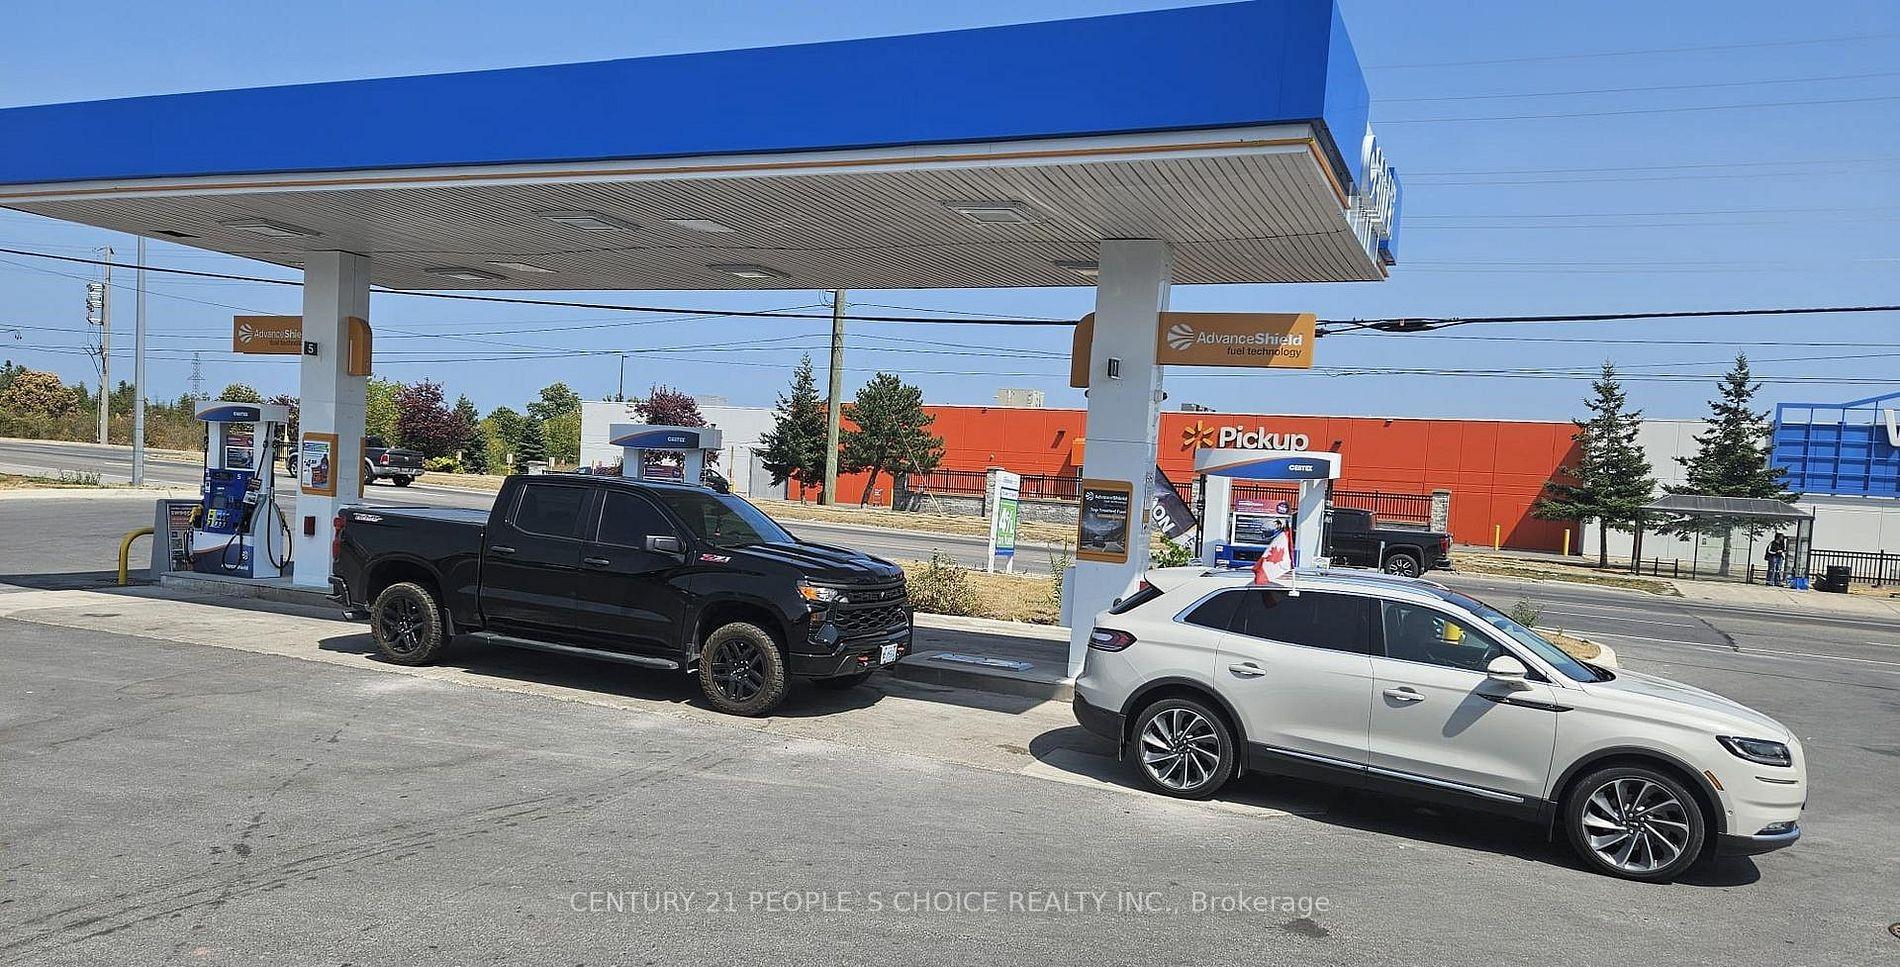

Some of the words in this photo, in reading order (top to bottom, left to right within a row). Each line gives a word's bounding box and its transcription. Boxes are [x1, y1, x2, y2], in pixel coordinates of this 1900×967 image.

[1196, 331, 1303, 345] AdvanceShield
[308, 343, 314, 354] 5
[1227, 346, 1245, 356] fuel
[1247, 347, 1302, 358] technology
[1219, 425, 1309, 452] Pickup
